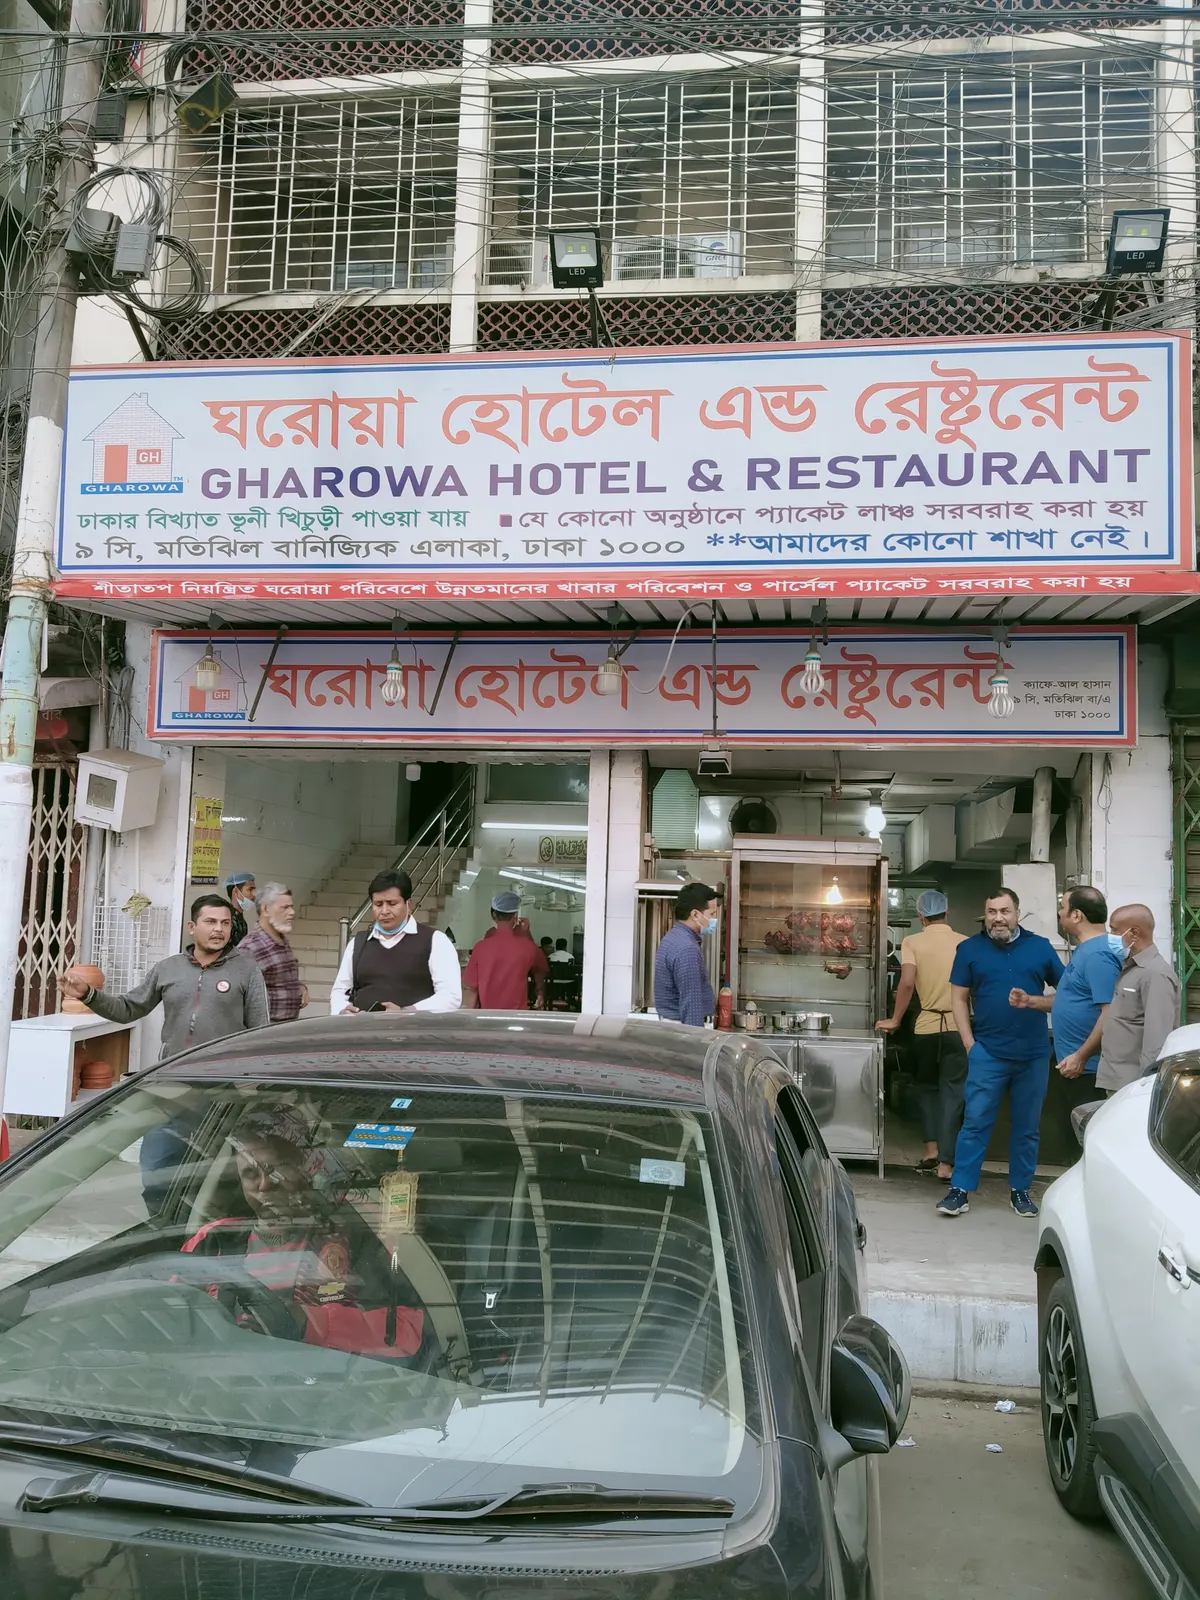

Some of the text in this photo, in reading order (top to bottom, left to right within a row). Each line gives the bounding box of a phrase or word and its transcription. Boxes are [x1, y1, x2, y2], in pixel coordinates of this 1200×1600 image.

[1126, 251, 1145, 260] LED
[568, 267, 586, 276] LED
[201, 355, 1152, 453] ঘরোয়া হোটেল এন্ড রেষ্টুরেন্ট
[138, 451, 161, 463] GH
[201, 448, 1151, 499] GHAROWA HOTEL & RESTAURANT
[86, 483, 179, 493] GHAROWA
[77, 504, 470, 534] ঢাকার বিখ্যাত ভূনী খিচুড়ী পাওয়া যায়
[519, 498, 1149, 530] যে কোনো অনুষ্ঠানে প্যাকেট লাঞ্চ সরবরাহ করা হয়
[883, 530, 978, 552] কোনো
[986, 527, 1059, 550] শাখা
[74, 534, 685, 563] ৯ সি, মতিঝিল বানিজ্যিক এলাকা, ঢাকা ১০০০
[92, 575, 1135, 596] শীতাতপ নিয়ন্ত্রিত ঘরোয়া পরিবেশে উন্নতমানের খাবার পরিবেশন ও পার্সেল প্যাকেট সরবরাহ করা হয়
[658, 664, 760, 711] এন্ড
[1023, 680, 1112, 690] ক্যাফে-আল হাসান
[214, 691, 229, 700] GH
[1043, 693, 1084, 704] মতিঝিল
[1087, 695, 1111, 706] বা/এ
[1054, 710, 1111, 719] ঢাকা ১০০০
